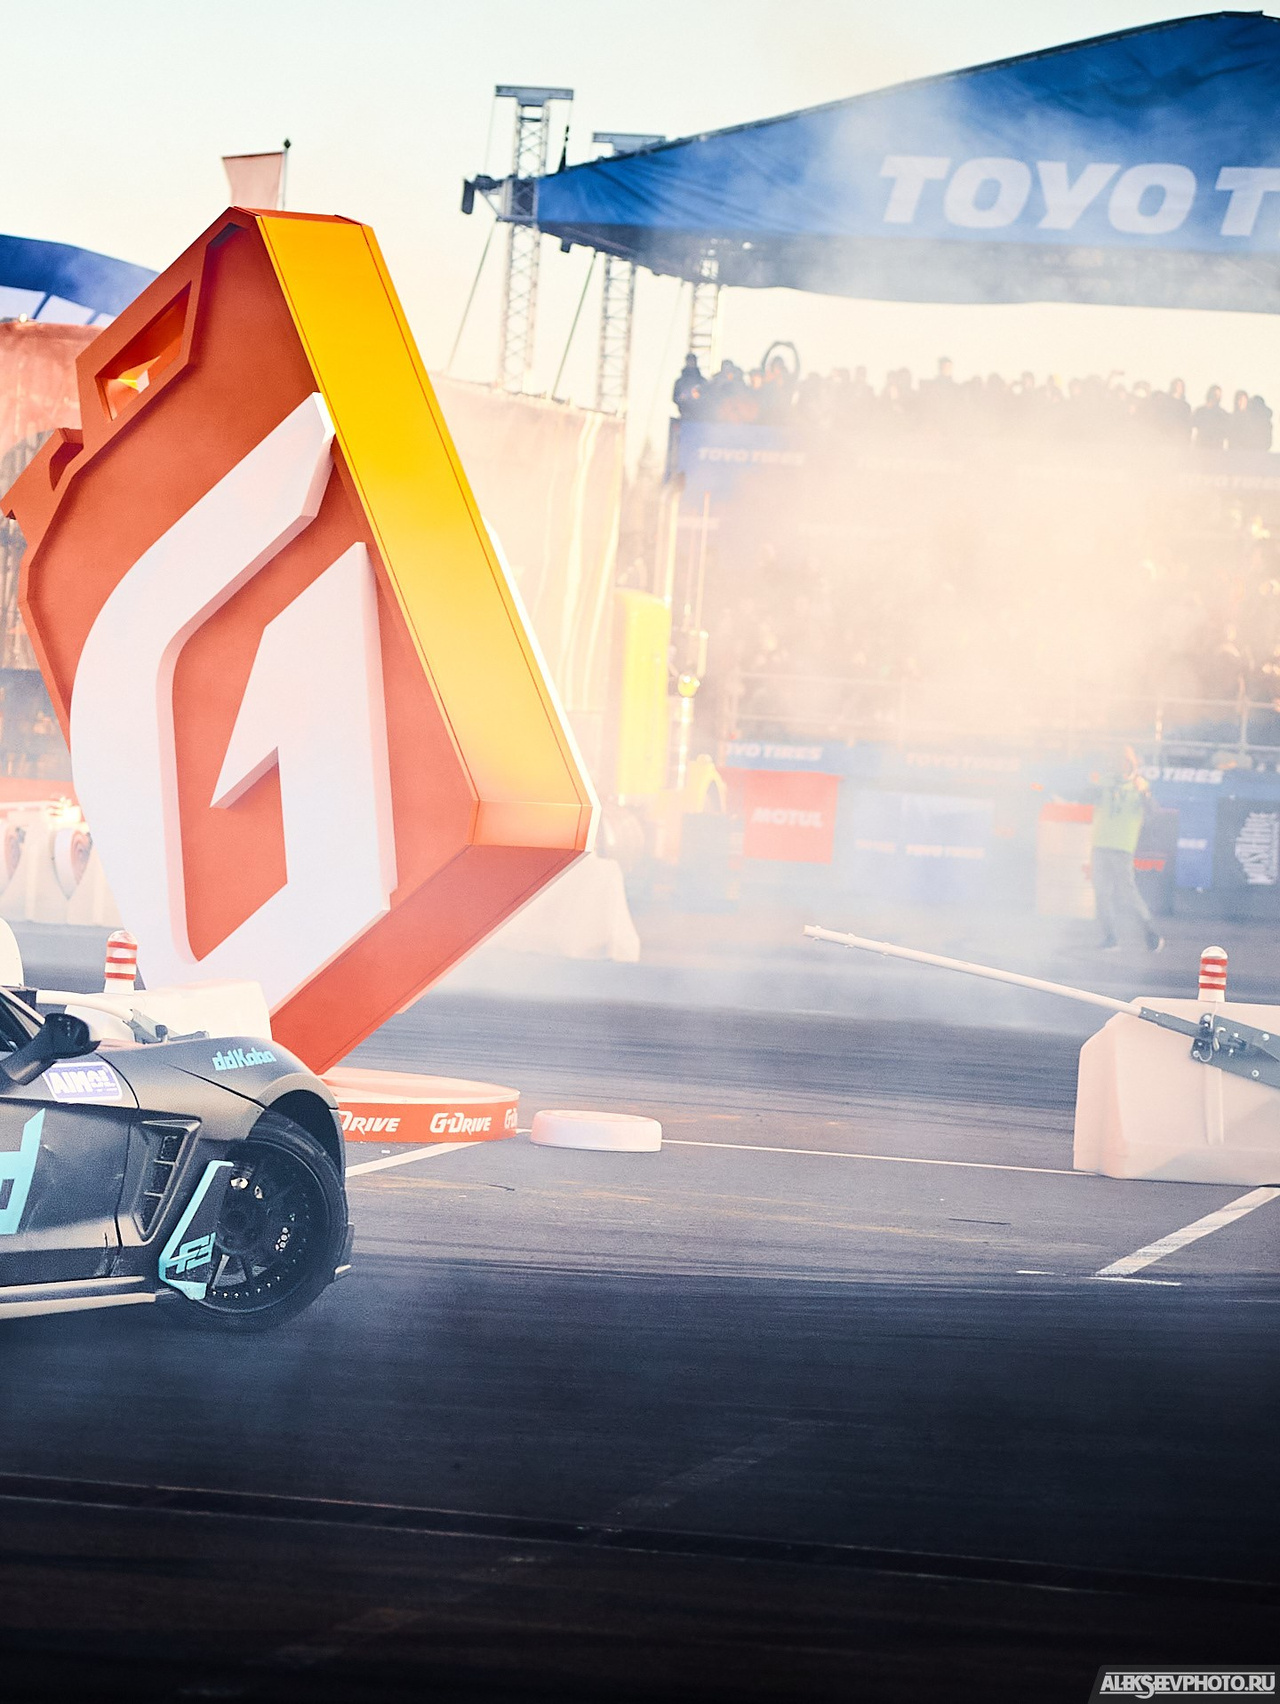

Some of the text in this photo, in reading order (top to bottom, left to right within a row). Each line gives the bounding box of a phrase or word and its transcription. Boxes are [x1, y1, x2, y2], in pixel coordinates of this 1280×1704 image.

[880, 154, 1197, 235] TOYO
[1163, 767, 1224, 784] TIRES
[750, 807, 824, 829] MOTUL
[338, 1110, 401, 1135] DRIVE
